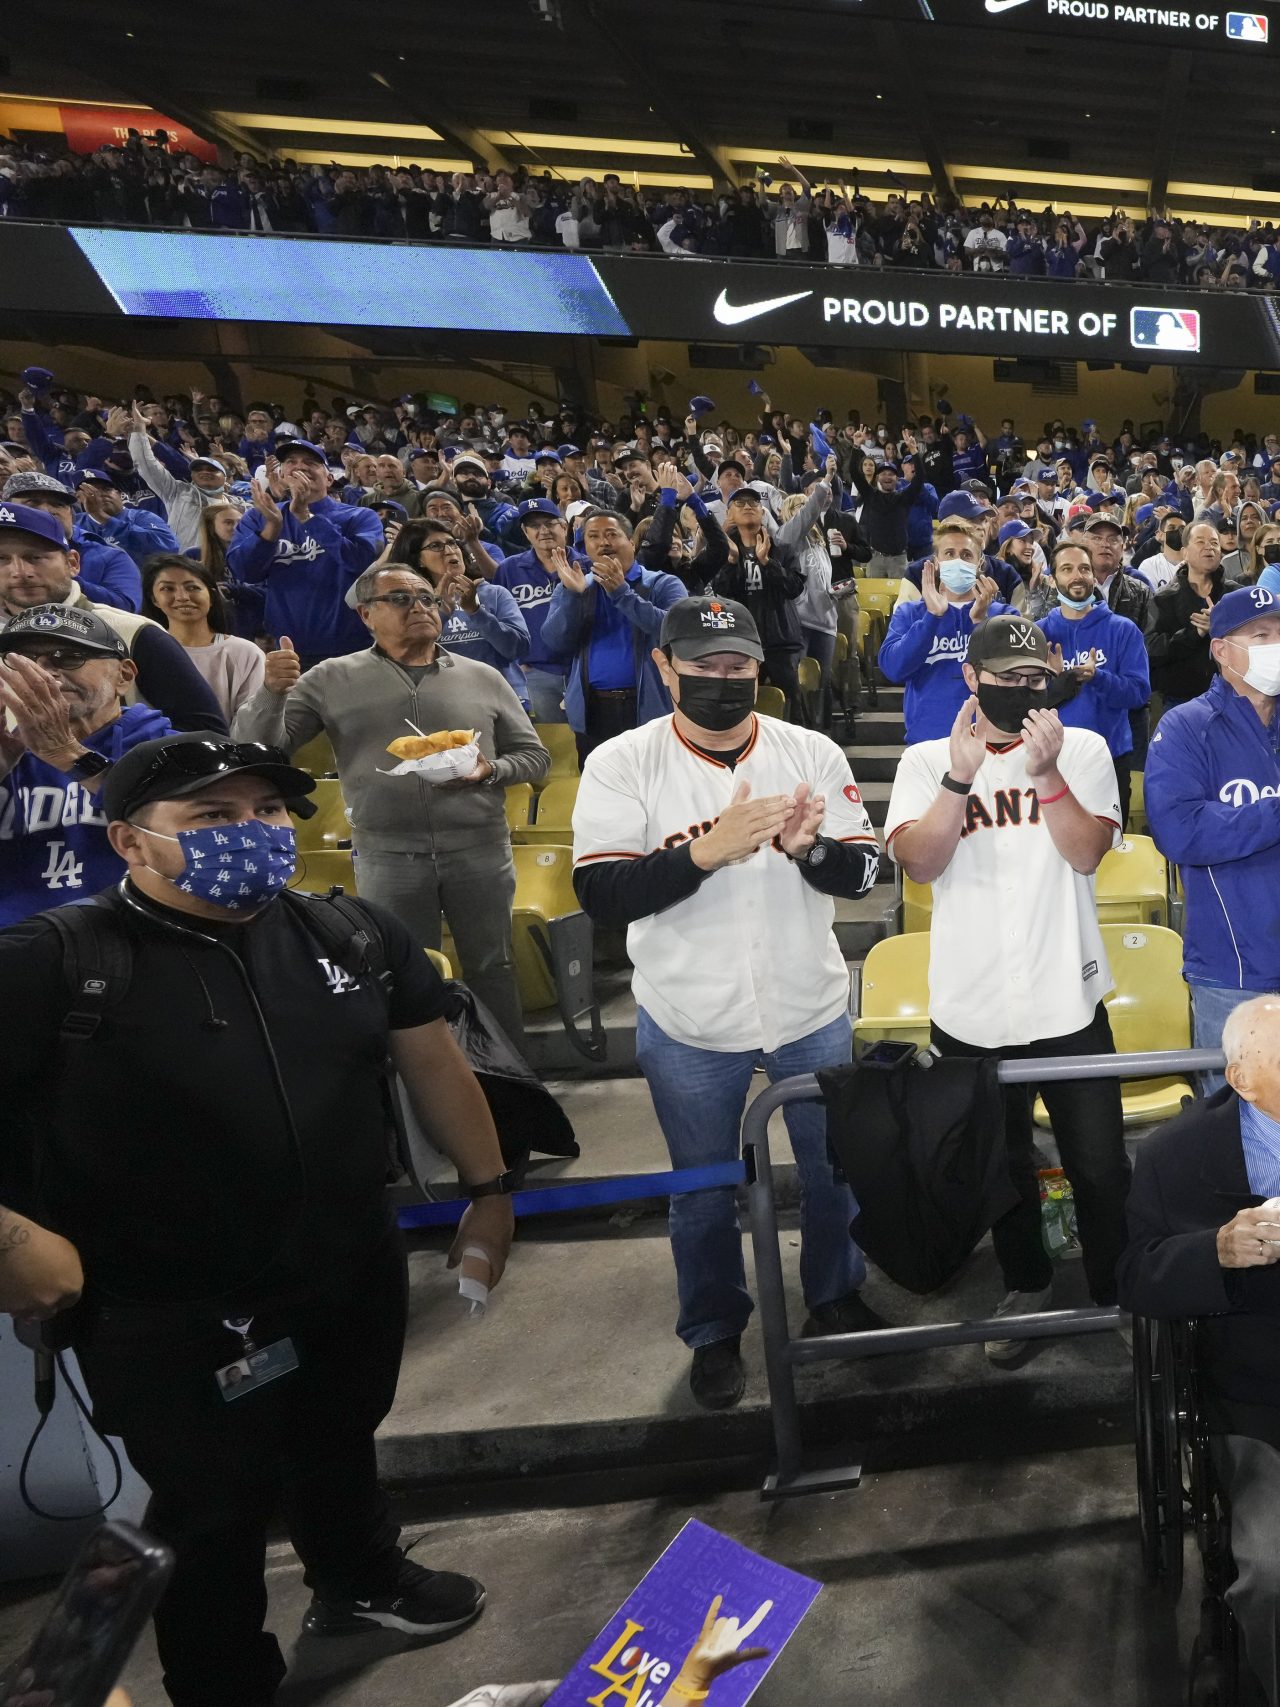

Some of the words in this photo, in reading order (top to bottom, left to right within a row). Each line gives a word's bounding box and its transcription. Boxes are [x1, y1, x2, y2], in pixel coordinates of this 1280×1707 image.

[1047, 0, 1110, 20] PROUD
[1114, 4, 1191, 28] PARTNER
[1195, 13, 1220, 31] OF
[823, 296, 930, 327] PROUD
[939, 303, 1070, 335] PARTNER
[1078, 311, 1117, 337] OF
[276, 536, 325, 562] Dodg
[1250, 587, 1274, 609] D
[701, 611, 736, 623] NLCS
[41, 841, 84, 889] LA
[1132, 936, 1138, 945] 2
[317, 958, 361, 994] LA
[589, 1618, 671, 1685] Love
